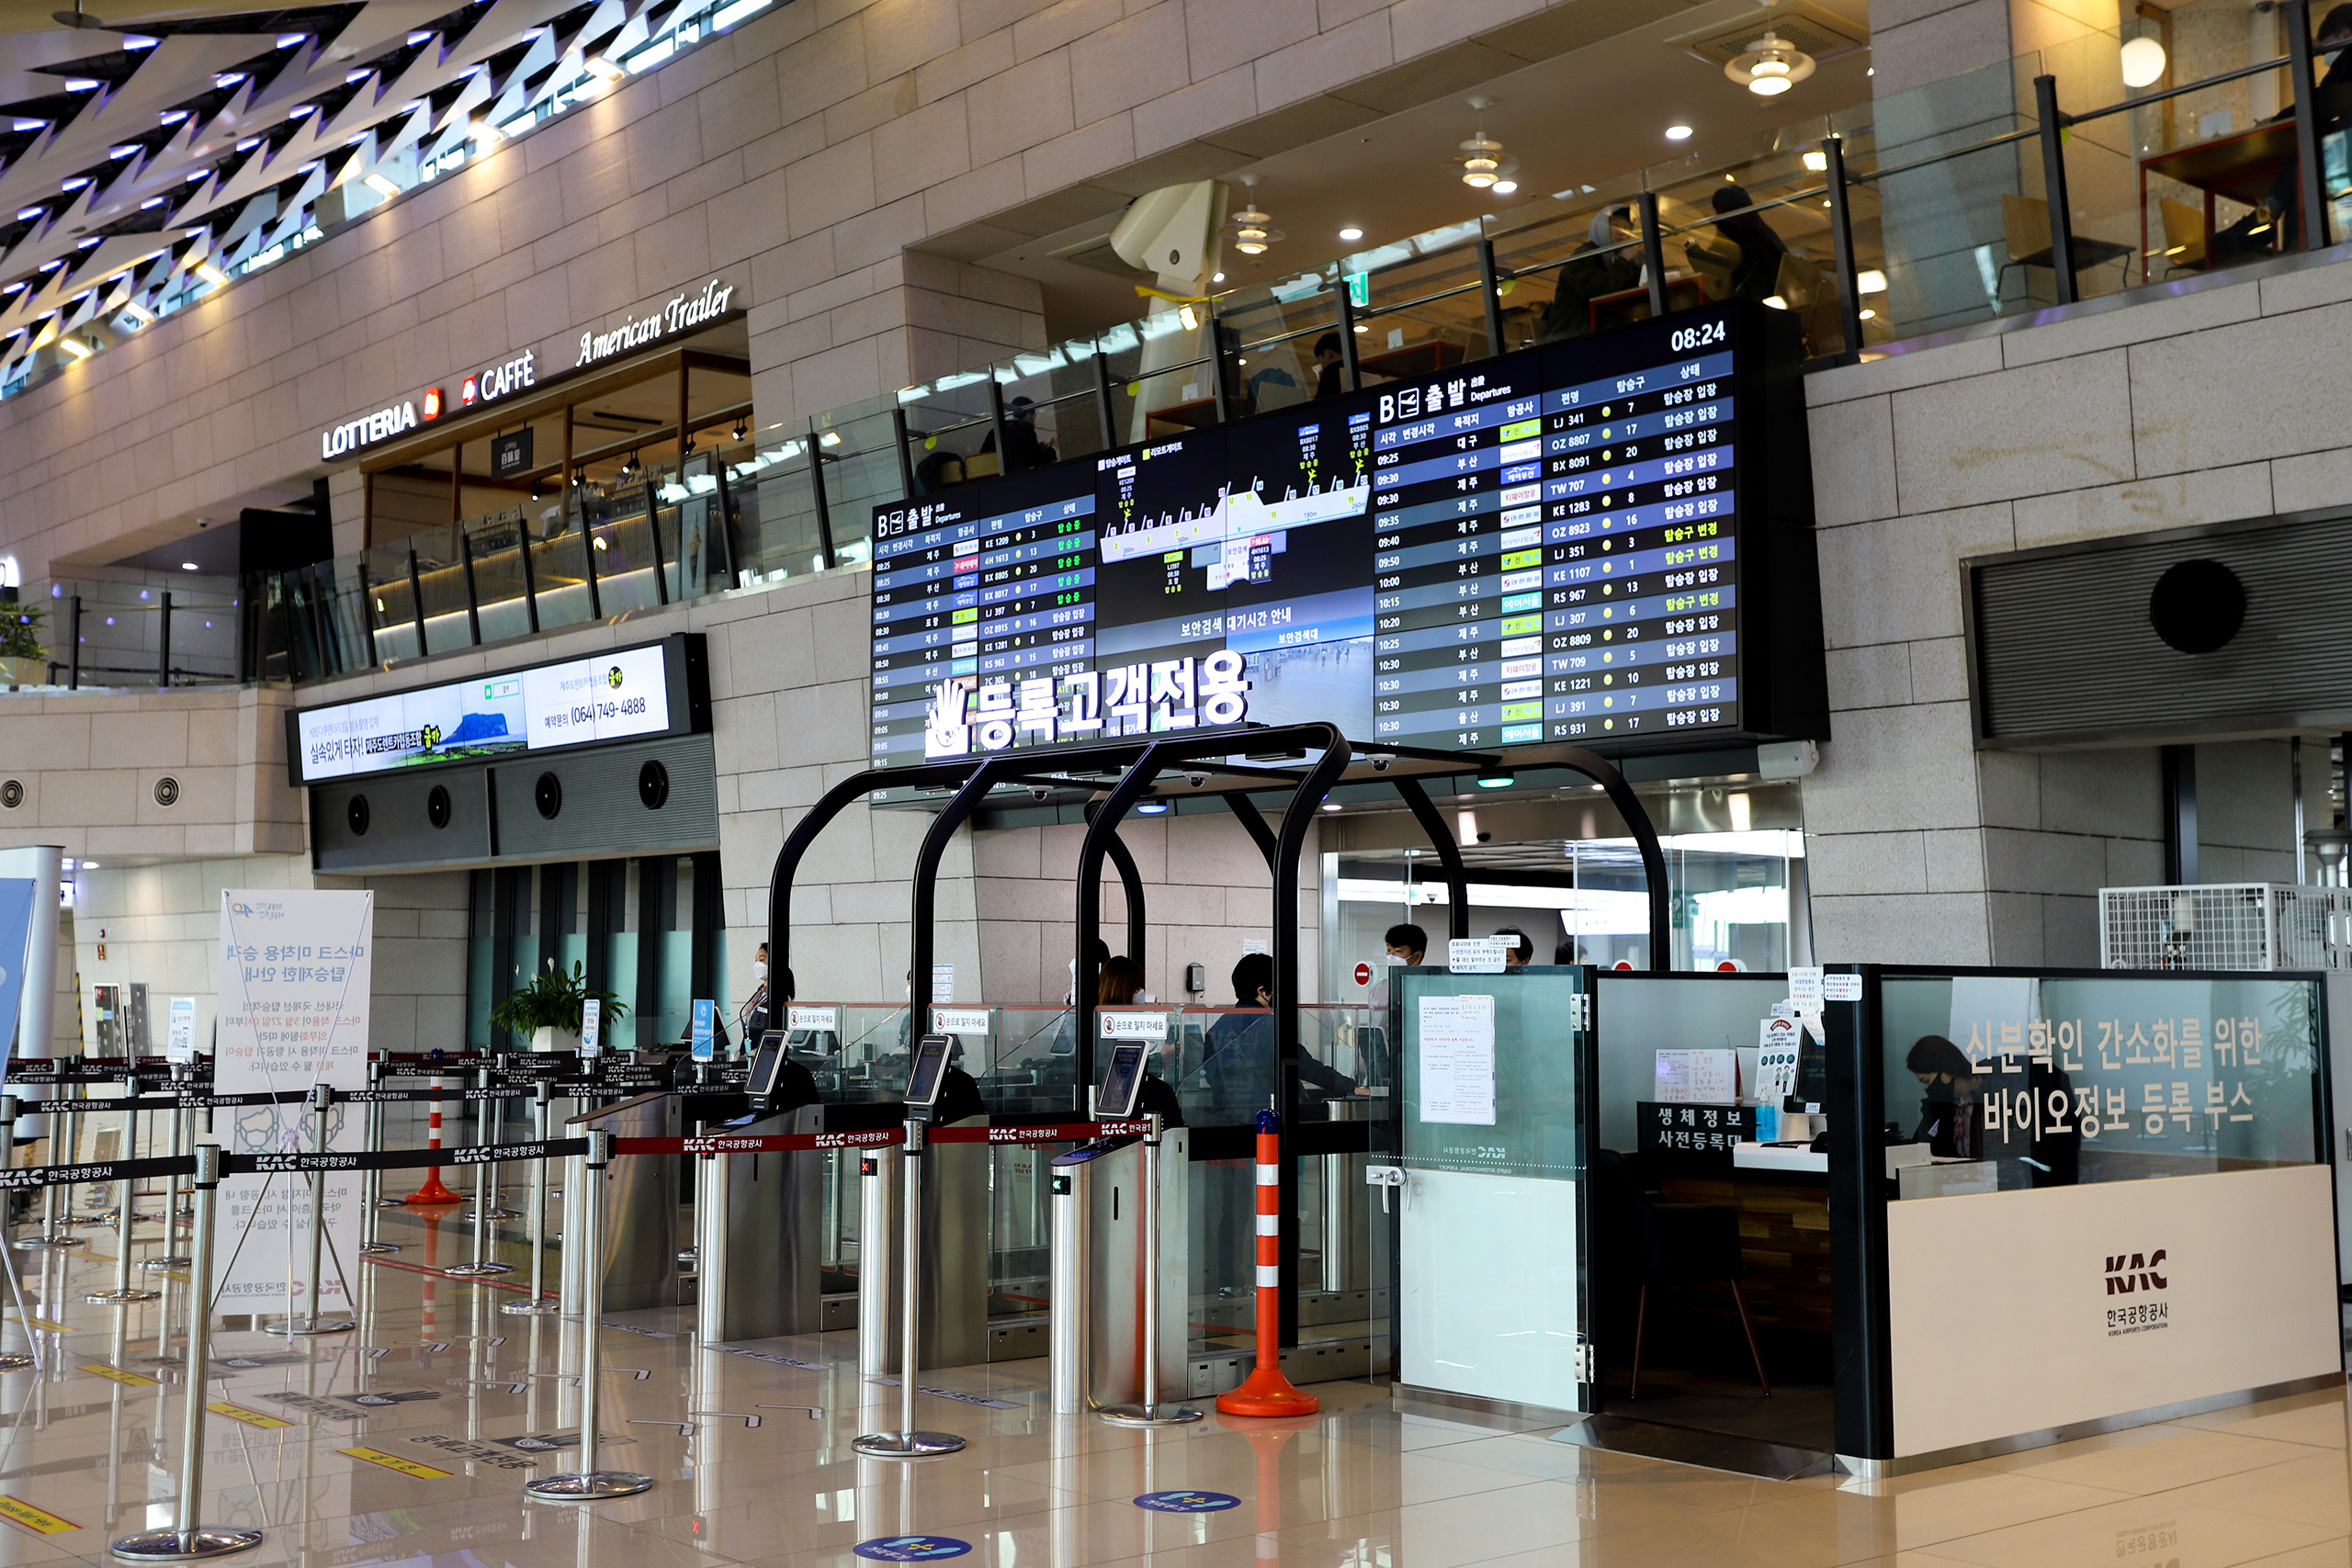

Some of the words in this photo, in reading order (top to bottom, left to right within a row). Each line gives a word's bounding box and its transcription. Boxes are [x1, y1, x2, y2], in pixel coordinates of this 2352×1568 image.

[575, 313, 662, 367] American
[664, 278, 733, 333] Trailer
[1671, 321, 1725, 351] 08:24
[1380, 432, 1396, 445] 시각
[1453, 412, 1479, 429] 목적지
[1507, 401, 1533, 418] 항공사
[1561, 390, 1579, 405] 편명
[1617, 376, 1645, 393] 탑승구
[1680, 363, 1700, 379] 상태
[1471, 386, 1511, 401] Departures
[1380, 395, 1395, 423] B
[322, 401, 416, 459] LOTTERIA
[1378, 452, 1398, 466] 09:25
[1554, 418, 1564, 428] LJ
[1568, 413, 1584, 426] 341
[1628, 402, 1634, 412] 7
[1664, 389, 1693, 405] 탑승장
[1697, 383, 1717, 400] 입장
[1378, 473, 1398, 486] 09:30
[1552, 439, 1566, 451] OZ
[1568, 434, 1590, 447] 8807
[1626, 423, 1637, 435] 17
[1665, 411, 1694, 428] 탑승장
[1698, 405, 1718, 421] 입장
[1378, 515, 1399, 528] 09:35
[1551, 482, 1566, 496] TW
[1568, 479, 1585, 492] 707
[1628, 470, 1634, 480] 4
[1665, 457, 1694, 475] 탑승장
[1697, 453, 1717, 468] 입장
[877, 514, 888, 537] B
[935, 512, 961, 524] Departures
[985, 540, 994, 548] KE
[994, 536, 1009, 547] 1209
[1031, 530, 1036, 538] 3
[985, 557, 994, 566] 4H
[995, 554, 1009, 564] 1613
[1030, 547, 1037, 556] 13
[1379, 617, 1400, 629] 10:20
[1554, 592, 1566, 604] RS
[1568, 589, 1586, 602] 967
[1627, 581, 1638, 592] 13
[1666, 570, 1695, 589] 탑승장
[1699, 568, 1719, 583] 입장
[1181, 617, 1222, 637] 보안검색
[1227, 609, 1267, 631] 대기시간
[1271, 606, 1292, 624] 안내
[1379, 638, 1399, 650] 10:25
[1555, 615, 1565, 626] LJ
[1569, 613, 1586, 625] 307
[1630, 604, 1635, 615] 6
[1666, 595, 1695, 612] 탑승구
[1699, 592, 1719, 606] 변경
[1278, 628, 1318, 644] 보안검색대
[985, 660, 993, 669] RS
[994, 659, 1005, 668] 963
[1030, 653, 1036, 661] 15
[1379, 700, 1399, 712] 10:30
[1554, 681, 1566, 692] KE
[1570, 678, 1591, 690] 1221
[1627, 672, 1639, 683] 10
[1666, 666, 1695, 681] 탑승장
[1699, 661, 1719, 677] 입장
[976, 649, 1250, 750] 등록고객전용
[544, 713, 569, 728] 예약문의
[571, 705, 595, 726] (064)
[311, 738, 344, 764] 실속있게
[345, 736, 365, 759] 타자!
[799, 1014, 810, 1023] 손으로
[821, 1015, 832, 1023] 마세요
[972, 1018, 985, 1027] 마세요
[1117, 1021, 1132, 1030] 손으로
[1147, 1021, 1163, 1031] 마세요
[1965, 1018, 2084, 1074] 신분확인
[2097, 1017, 2204, 1070] 간소화를
[2213, 1016, 2263, 1066] 위한
[350, 1091, 373, 1101] KAC
[466, 1089, 488, 1100] KAC
[569, 1087, 591, 1096] KAC
[40, 1100, 70, 1112] KAC
[72, 1101, 111, 1110] 한국공항공사
[1984, 1084, 2130, 1144] 바이오정보
[2141, 1081, 2194, 1135] 등록
[2204, 1080, 2254, 1131] 부스
[815, 1133, 845, 1147] KAC
[847, 1132, 889, 1144] 한국공항공사
[989, 1128, 1017, 1140] KAC
[1019, 1128, 1057, 1139] 한국공항공사
[453, 1147, 491, 1163] KAC
[493, 1145, 545, 1158] 한국공항공사
[683, 1138, 716, 1152] KAC
[718, 1138, 763, 1148] 한국공항공사
[255, 1156, 297, 1170] KAC
[300, 1156, 357, 1168] 한국공항공사
[0, 1168, 43, 1187] KAC
[48, 1167, 113, 1182] 한국공항공사
[2104, 1249, 2167, 1295] KAC
[2107, 1302, 2168, 1327] 한국공항공사
[2109, 1328, 2121, 1337] KOREA
[2122, 1326, 2141, 1335] AIRPORTS
[2142, 1323, 2168, 1331] CORPORATION
